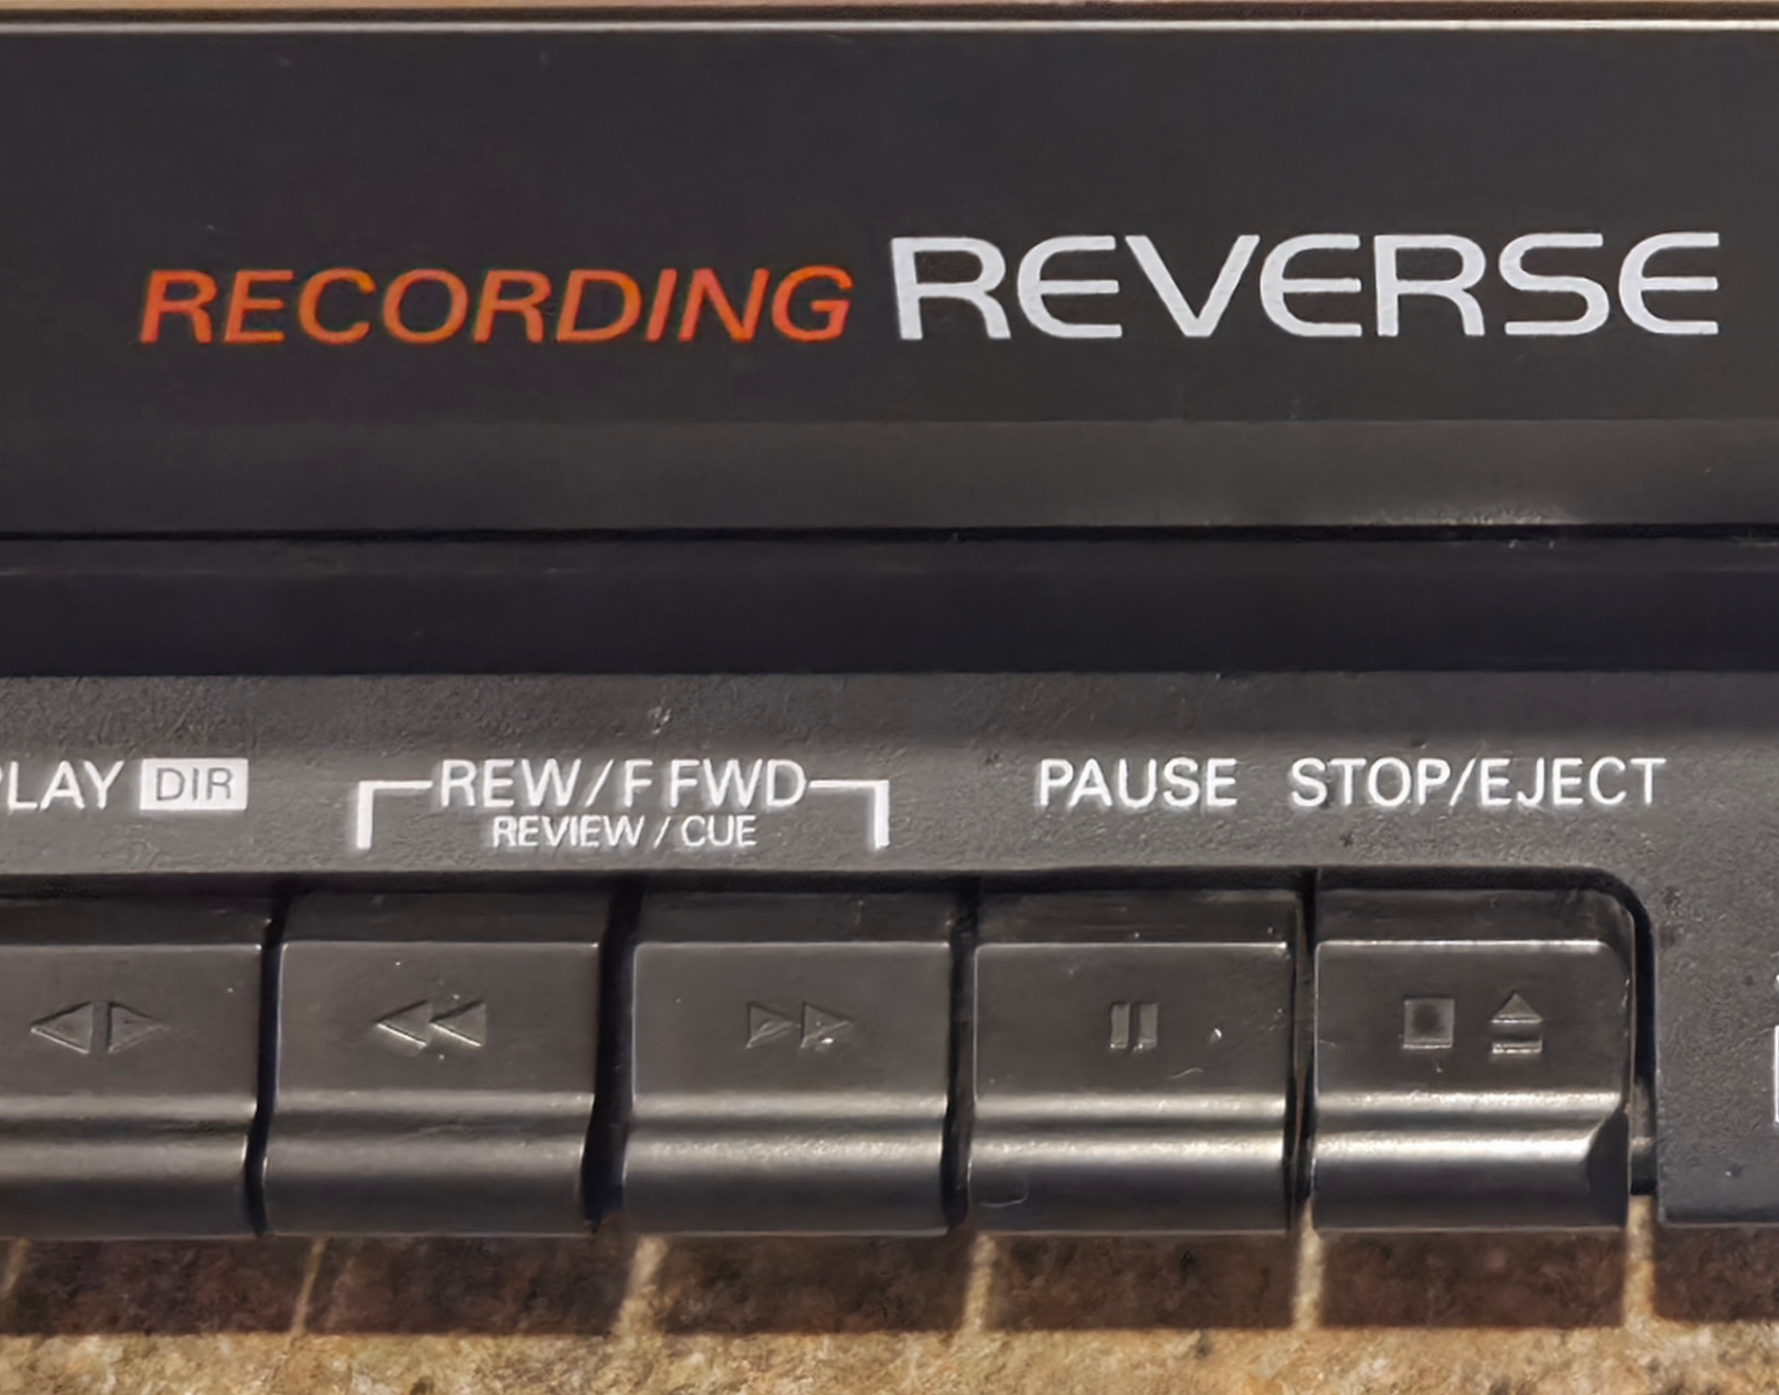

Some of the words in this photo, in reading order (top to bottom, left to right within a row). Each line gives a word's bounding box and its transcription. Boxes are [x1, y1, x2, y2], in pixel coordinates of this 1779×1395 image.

[140, 265, 853, 345] RECORDING
[890, 231, 1720, 340] REVERSE
[147, 762, 241, 808] DIR
[1038, 757, 1238, 810] PAUSE
[1289, 756, 1667, 809] STOP/EJECT
